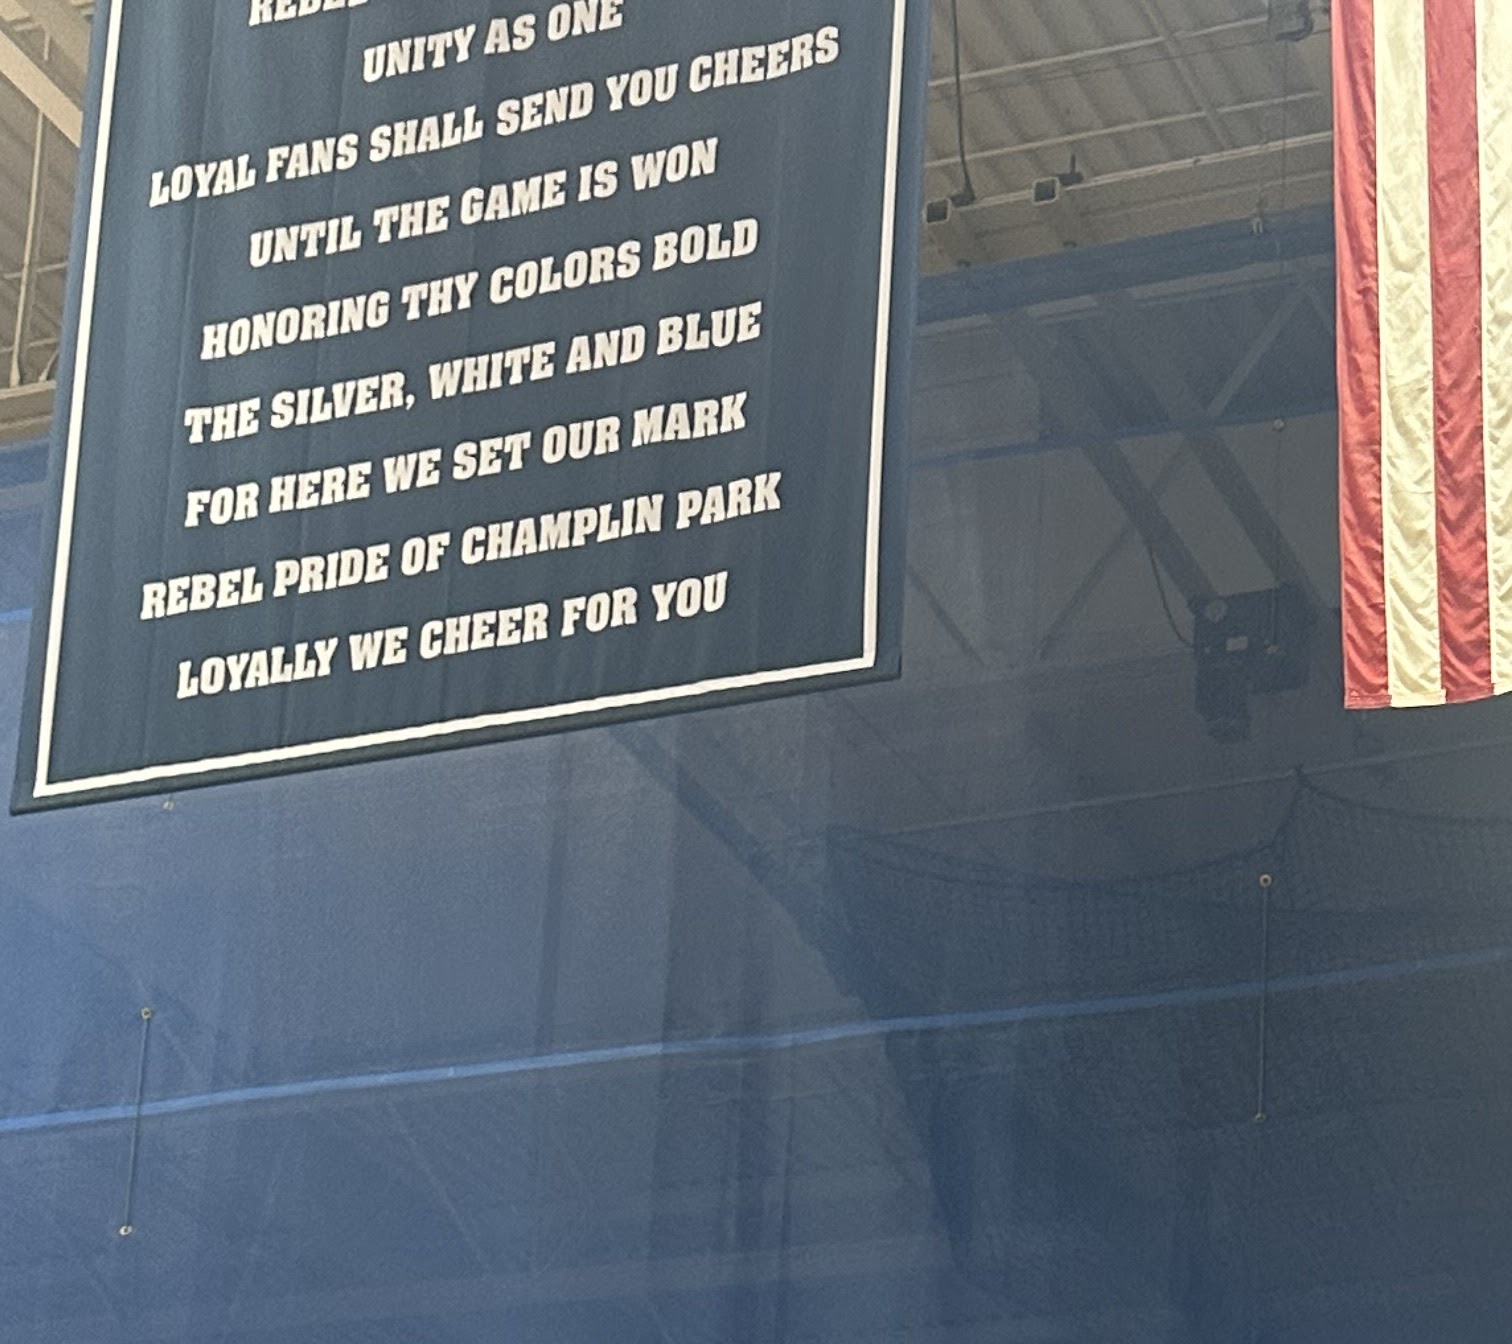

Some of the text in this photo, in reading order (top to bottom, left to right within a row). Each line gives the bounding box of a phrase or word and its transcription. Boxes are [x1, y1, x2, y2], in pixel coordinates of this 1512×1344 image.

[363, 0, 624, 83] UNITY AS ONE
[148, 25, 839, 209] LOYAL FANS SHALL SEND YOU CHEERS
[249, 136, 719, 268] UNTIL THE GAME IS WON
[200, 218, 758, 361] HONORING THY COLORS BOLD
[183, 300, 762, 444] THE SILVER, WHITE AND BLUE
[184, 391, 747, 528] FOR HERE WE SET OUR MARK
[139, 471, 782, 621] REBEL PRIDE OF CHAMPLIN PARK
[176, 571, 728, 700] LOYALLY WE CHEER FOR YOU
